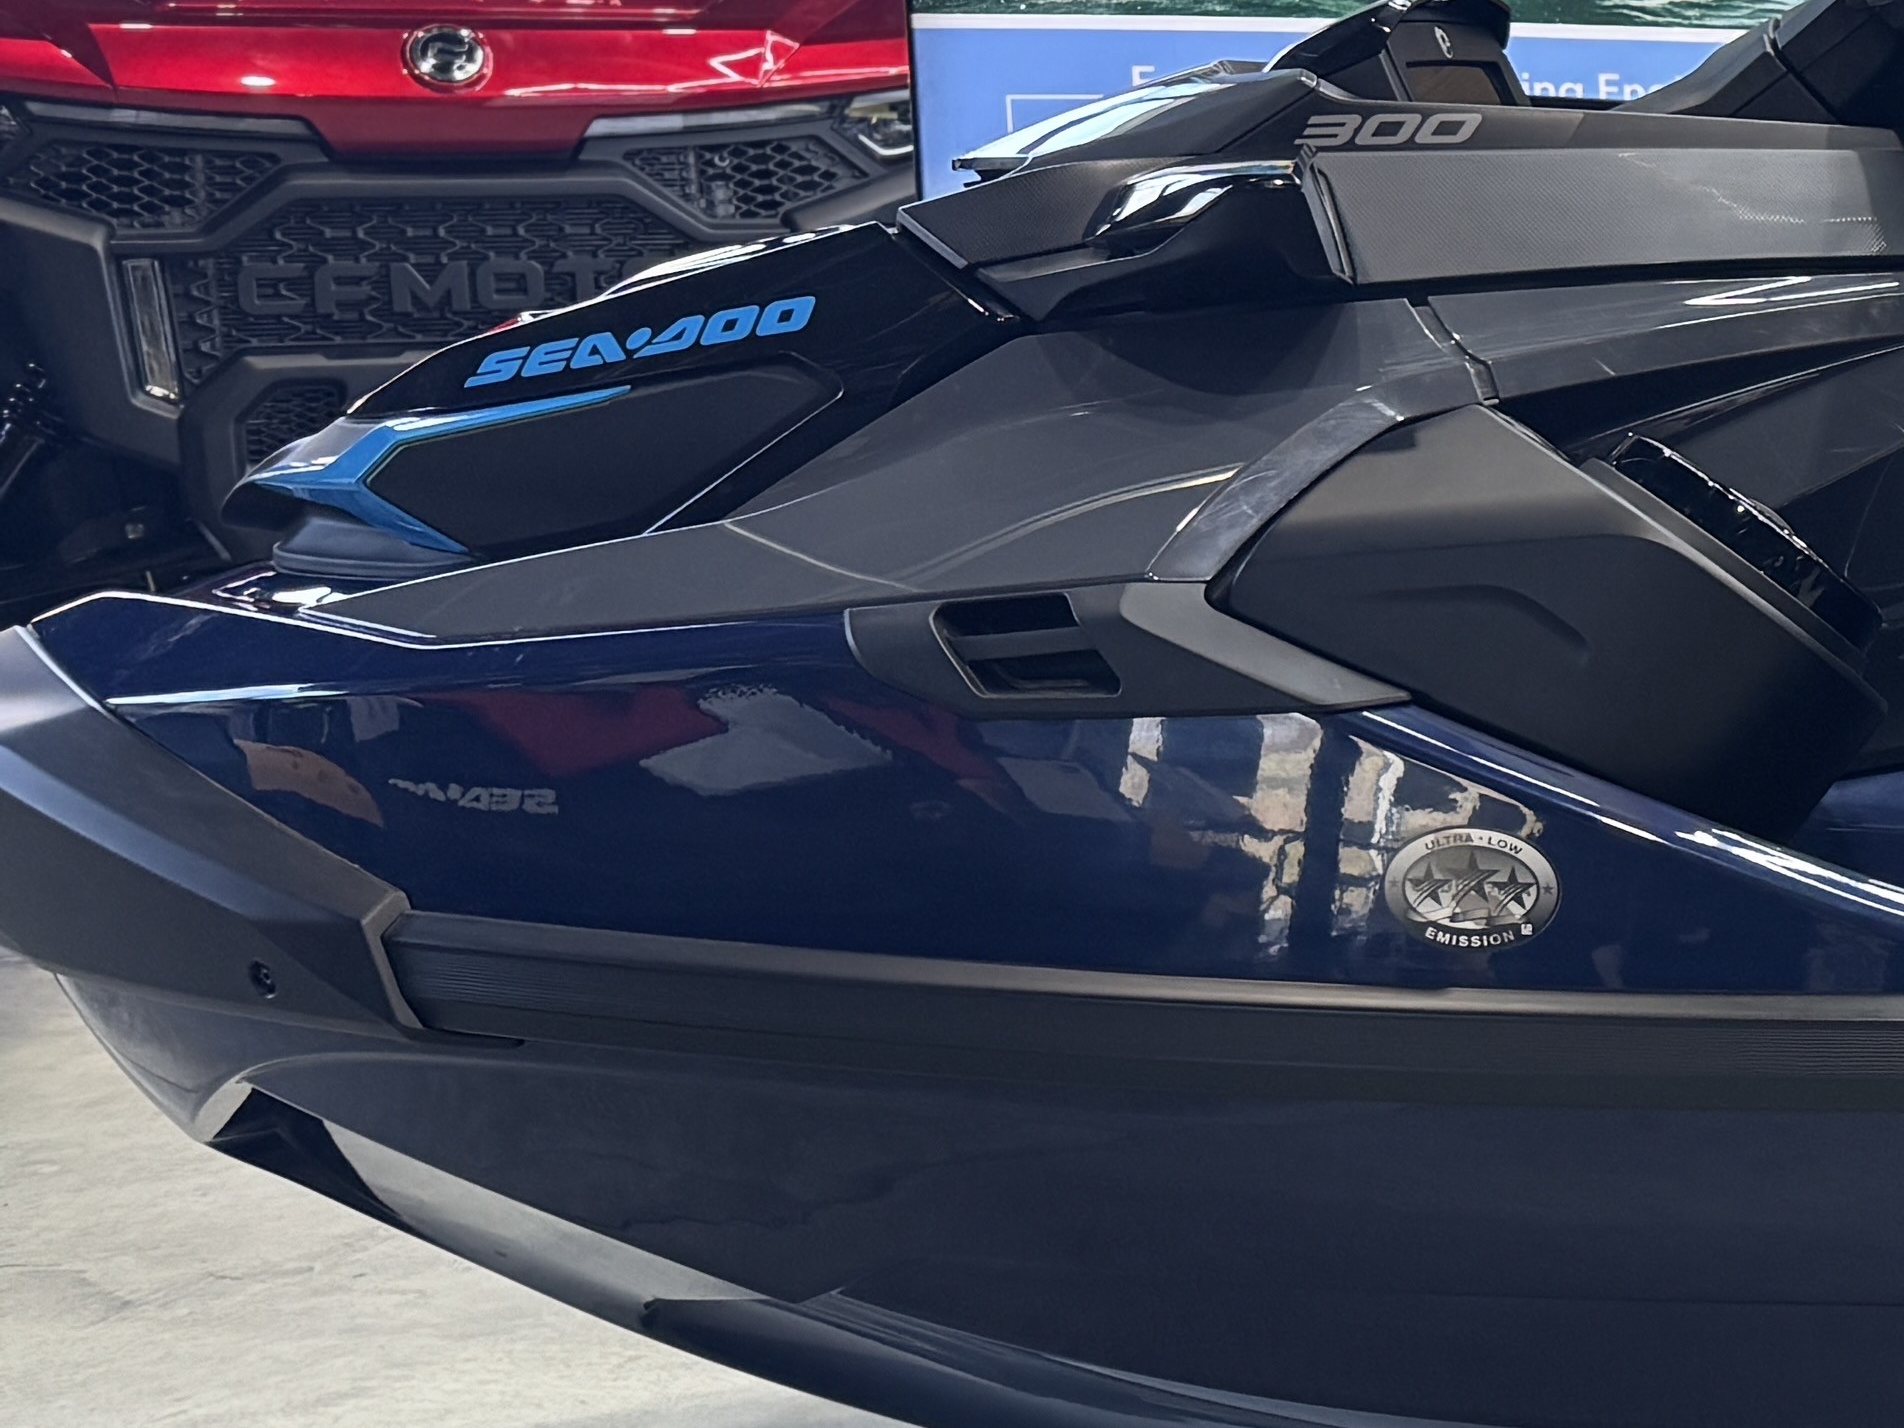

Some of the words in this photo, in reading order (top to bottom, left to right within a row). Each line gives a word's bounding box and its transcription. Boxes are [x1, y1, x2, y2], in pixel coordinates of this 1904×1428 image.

[1293, 113, 1482, 147] 300
[1425, 833, 1474, 850] ULTRA
[1488, 836, 1523, 854] LOW
[1425, 927, 1514, 947] EMISSION
